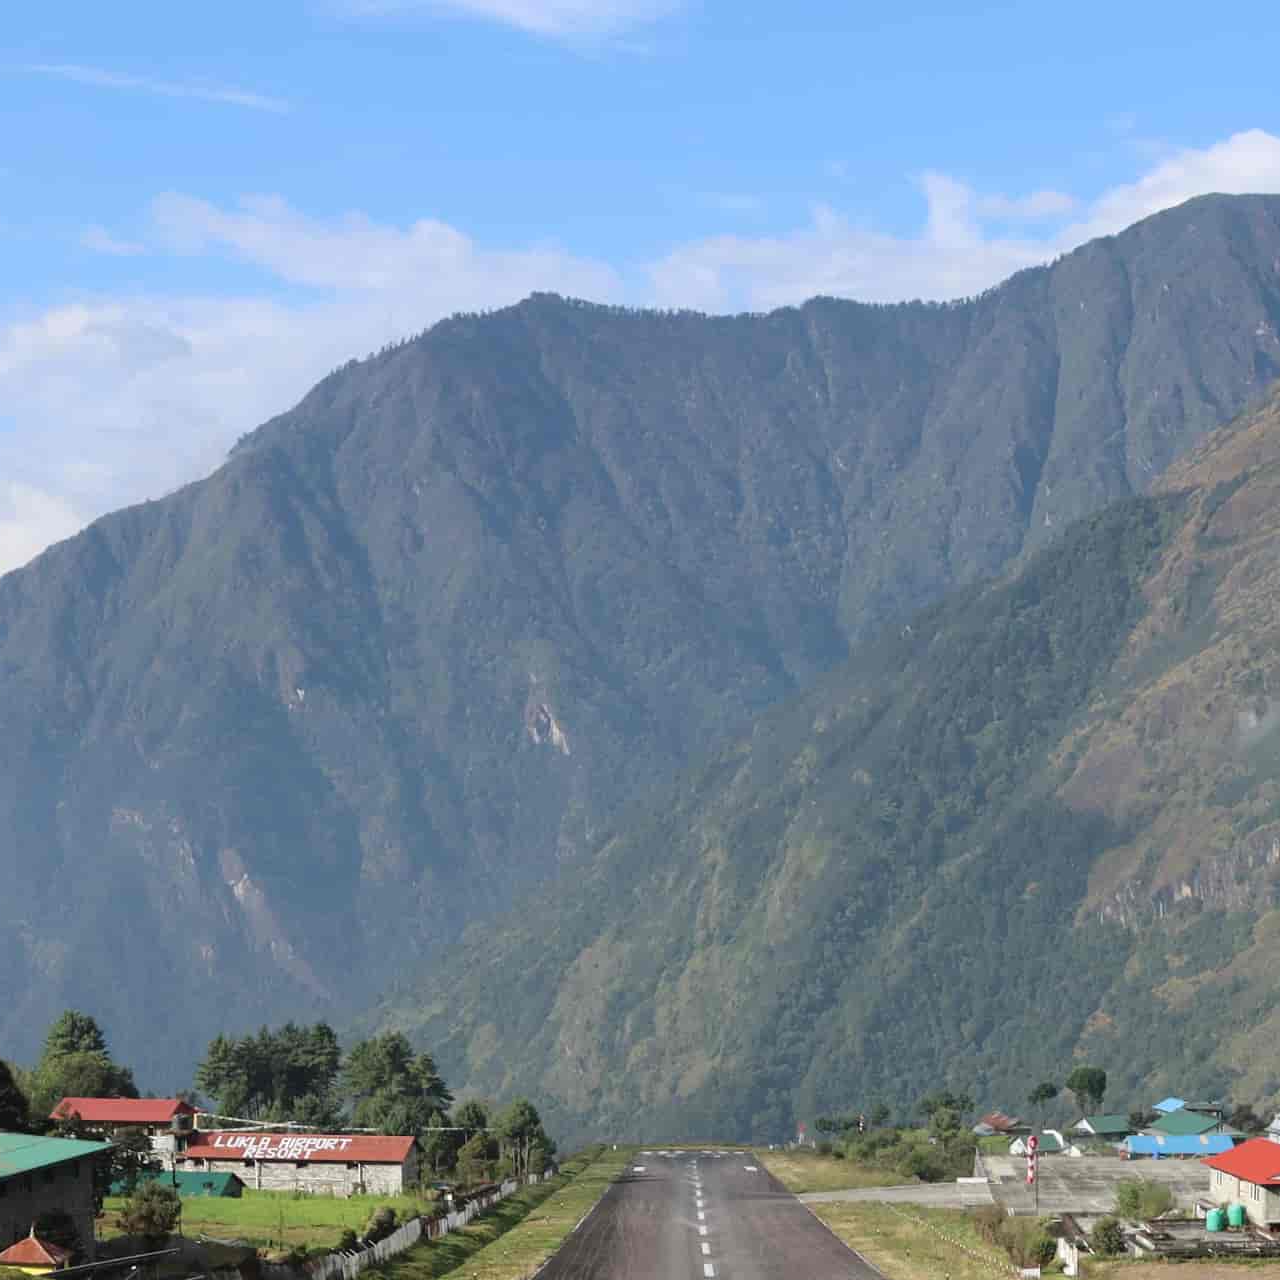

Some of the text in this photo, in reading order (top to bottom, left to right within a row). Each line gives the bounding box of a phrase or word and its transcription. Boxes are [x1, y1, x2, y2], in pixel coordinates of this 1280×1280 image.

[214, 1135, 352, 1151] LUKLA AIRPORT
[242, 1147, 316, 1159] RESORT
